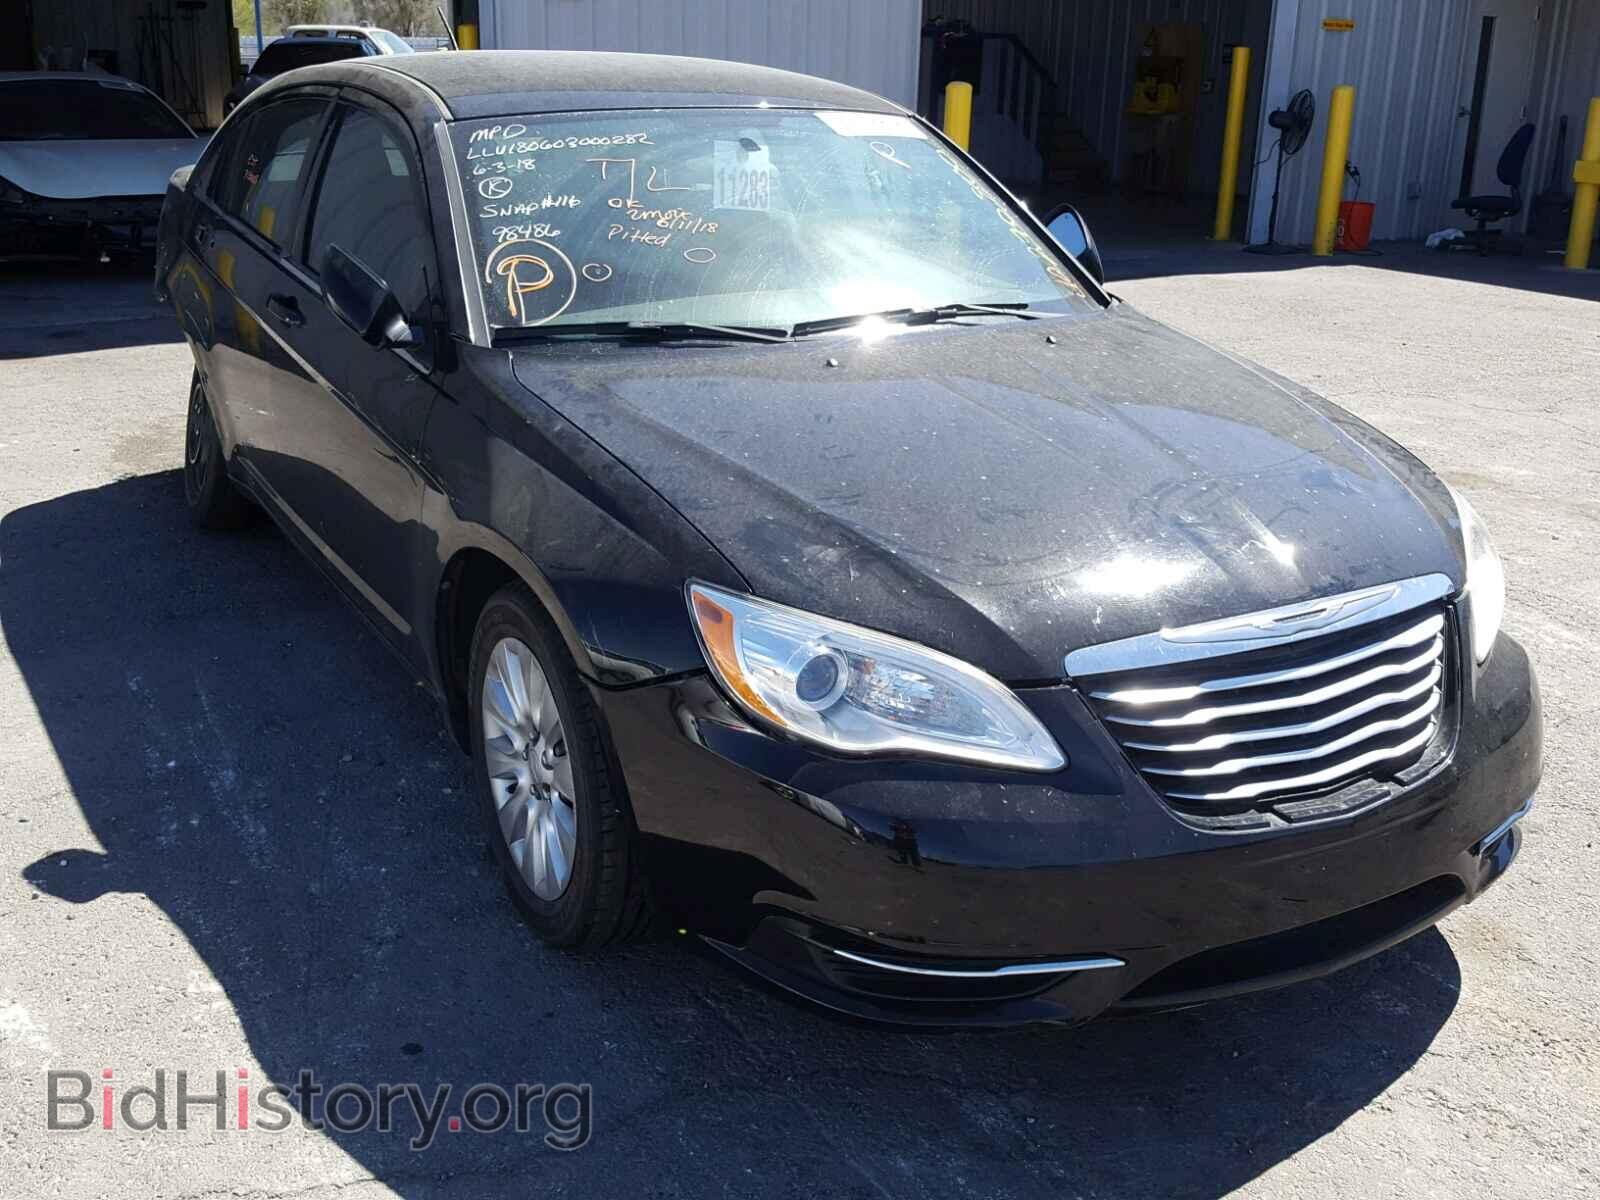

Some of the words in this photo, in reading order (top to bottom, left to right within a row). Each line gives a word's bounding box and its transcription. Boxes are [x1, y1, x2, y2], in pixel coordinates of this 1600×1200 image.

[469, 124, 527, 143] MPD
[473, 159, 536, 176] 6-3-18
[492, 223, 561, 243] 98486
[496, 254, 554, 325] P
